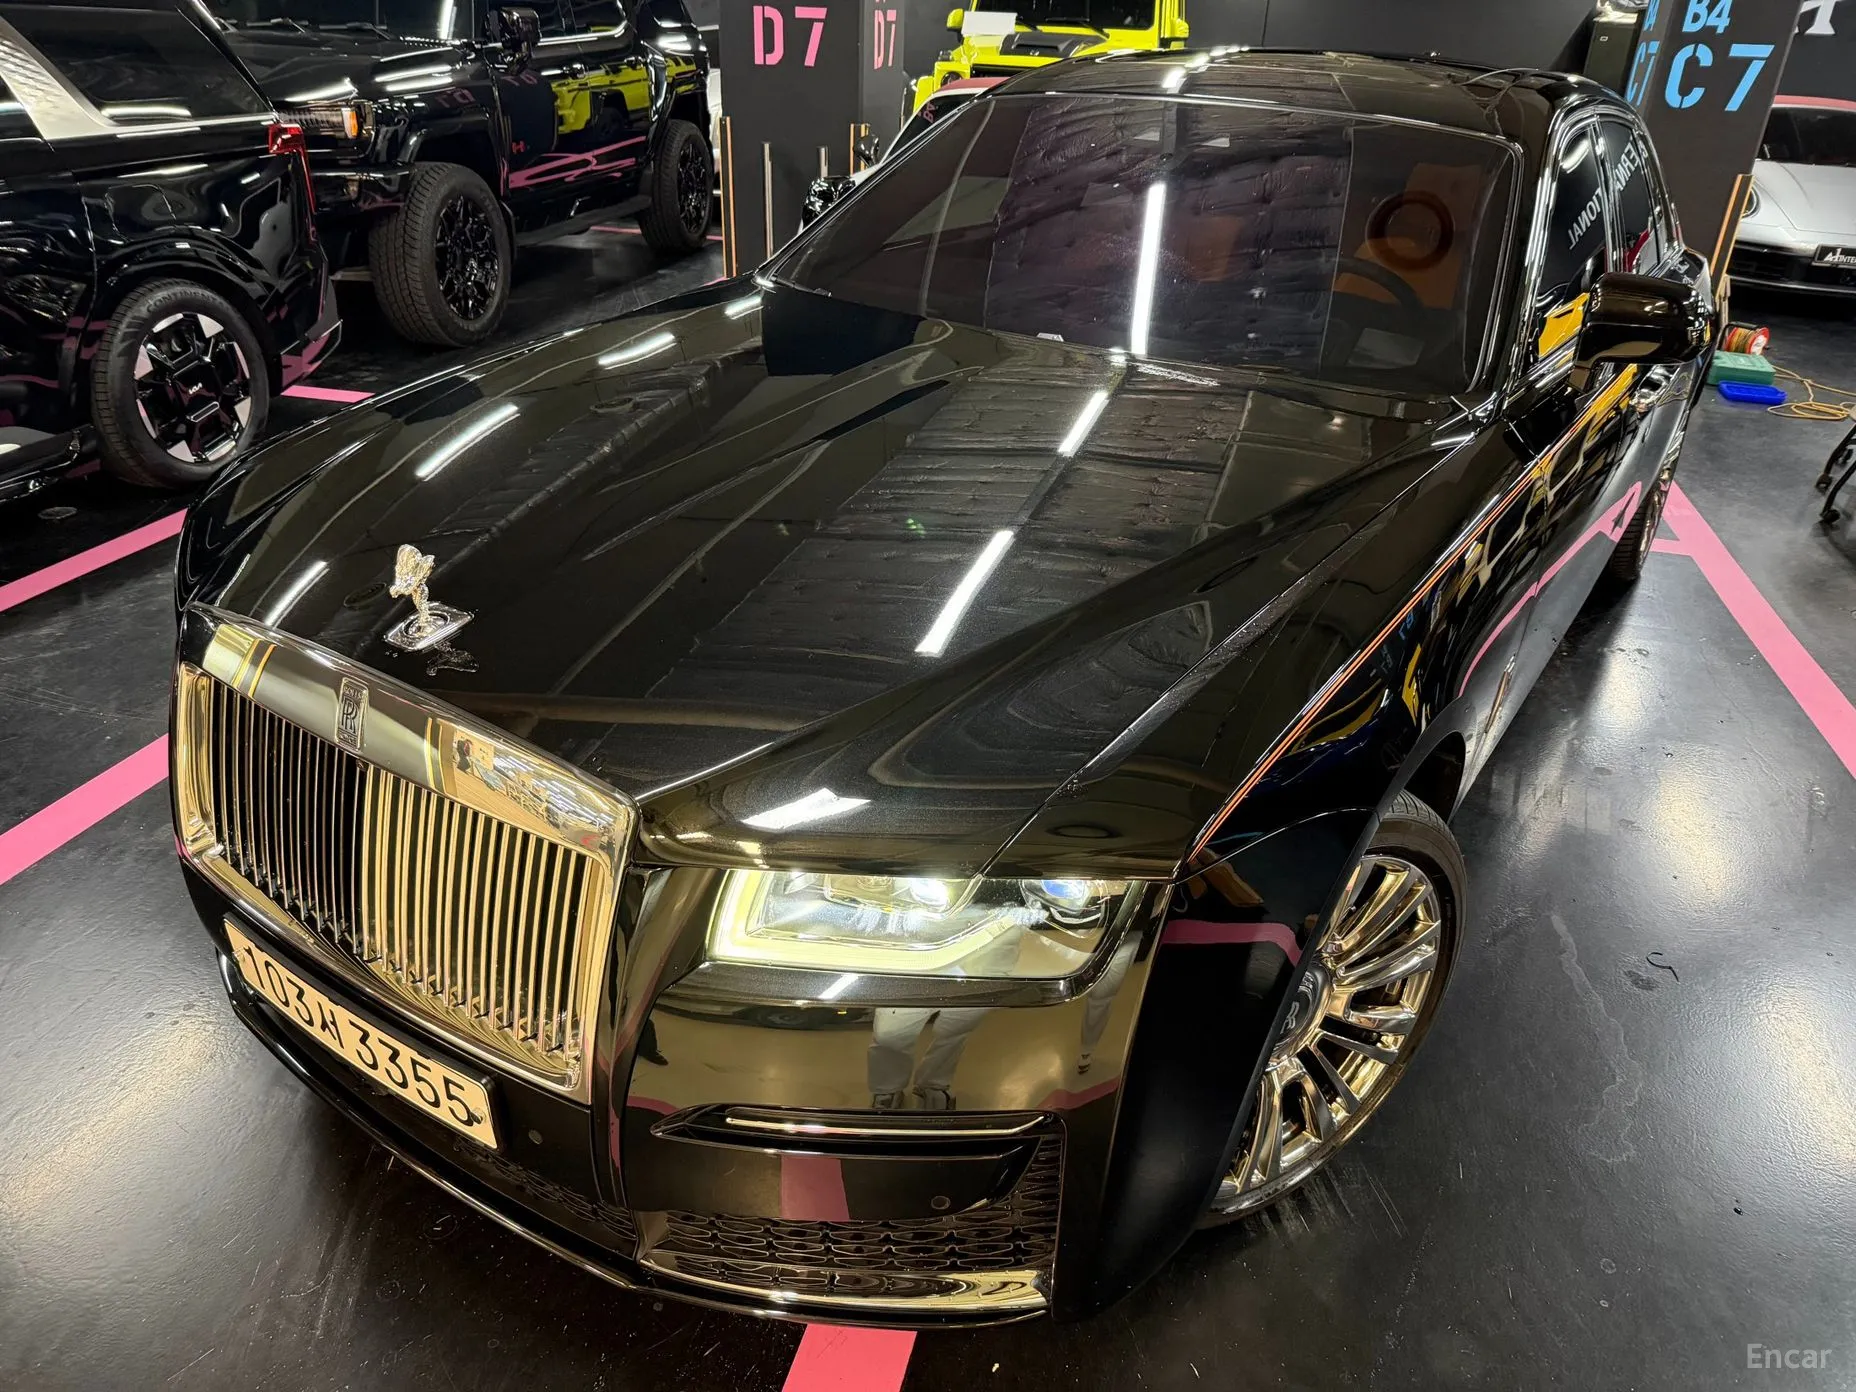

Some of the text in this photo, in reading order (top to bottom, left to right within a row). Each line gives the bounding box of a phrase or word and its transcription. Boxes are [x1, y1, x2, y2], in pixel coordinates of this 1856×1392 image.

[753, 5, 827, 67] D7
[873, 9, 897, 70] D7
[1664, 43, 1775, 112] C7
[348, 1018, 474, 1127] 3355
